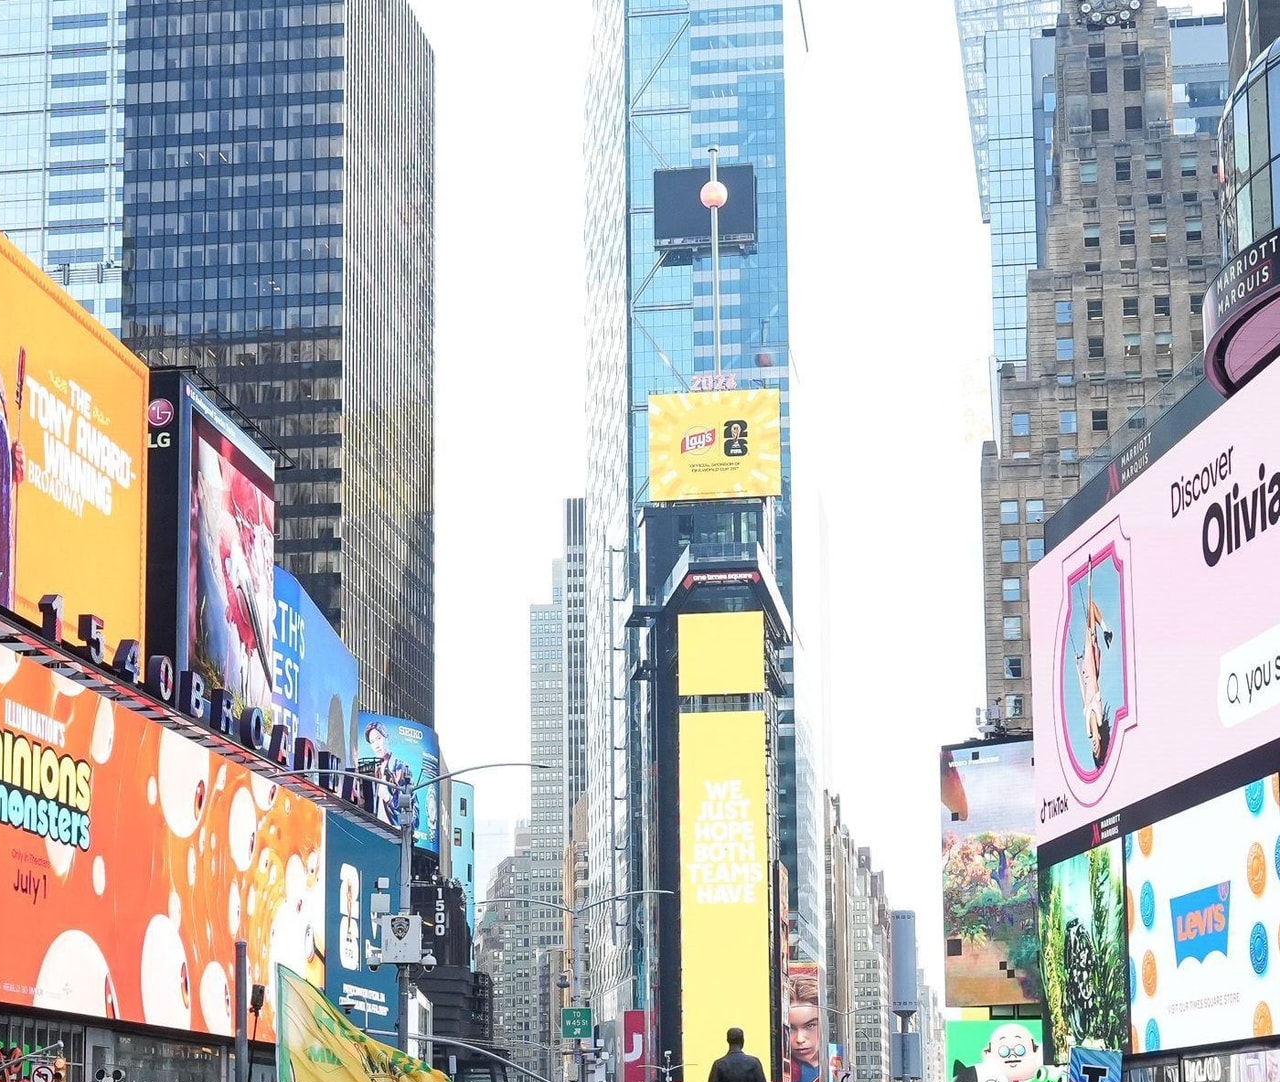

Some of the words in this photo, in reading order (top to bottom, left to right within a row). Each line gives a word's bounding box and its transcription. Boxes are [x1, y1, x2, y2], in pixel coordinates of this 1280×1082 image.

[1217, 234, 1279, 295] MARRIOTT
[1218, 265, 1272, 317] MARQUIS
[25, 374, 72, 436] TONY
[69, 380, 93, 418] THE
[28, 459, 87, 520] BROADWAY
[43, 430, 113, 516] WINNING
[1170, 444, 1235, 518] Discover
[1244, 653, 1273, 695] you
[398, 725, 424, 739] SEIKO
[704, 779, 742, 799] WE
[697, 800, 751, 820] JUST
[694, 821, 755, 841] HOPE
[693, 842, 755, 862] BOTH
[13, 869, 40, 905] July
[42, 874, 47, 899] 1
[688, 863, 763, 884] TEAMS
[435, 887, 445, 936] 1500
[697, 884, 757, 904] HAVE
